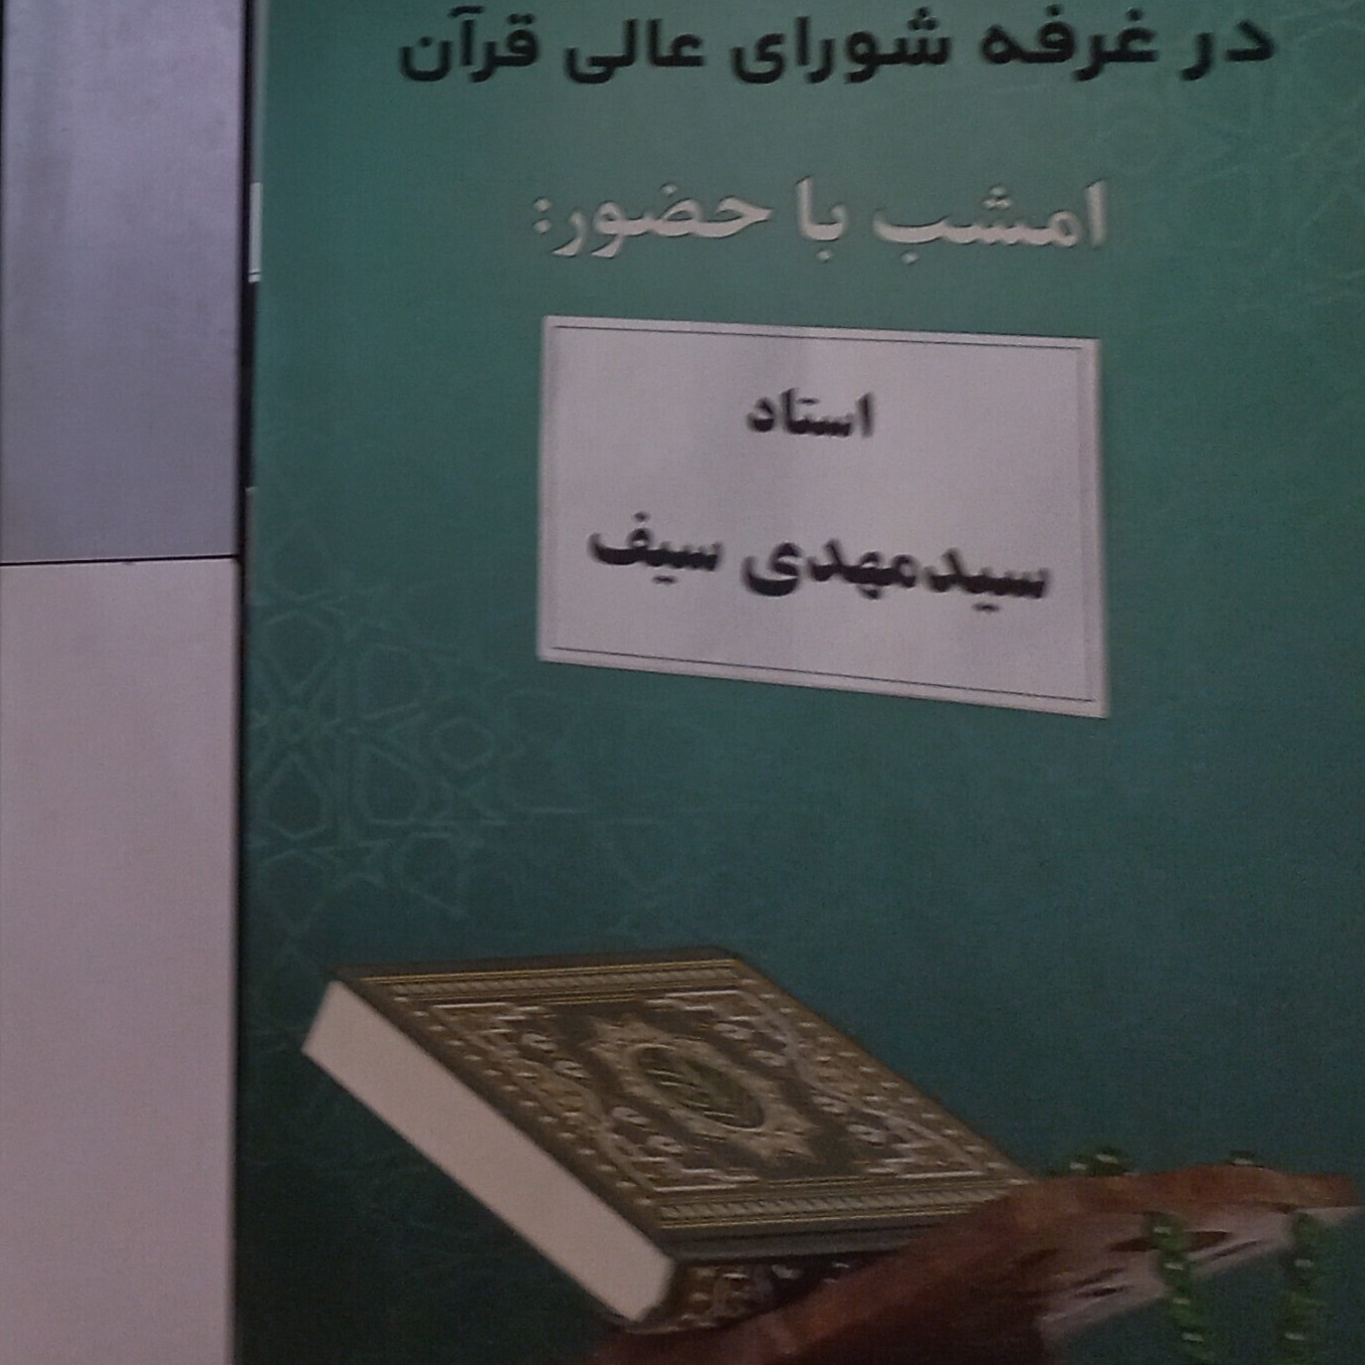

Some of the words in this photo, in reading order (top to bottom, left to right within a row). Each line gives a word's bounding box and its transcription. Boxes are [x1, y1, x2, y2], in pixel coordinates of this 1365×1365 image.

[399, 5, 540, 83] قرآن
[565, 17, 705, 85] عالی
[730, 4, 951, 85] شورای
[979, 3, 1159, 82] غرفه
[1179, 19, 1275, 82] در
[532, 183, 773, 259] حضور:
[796, 175, 847, 263] با
[872, 176, 1107, 265] امشب
[746, 388, 875, 438] استاد
[589, 511, 721, 584] سیف
